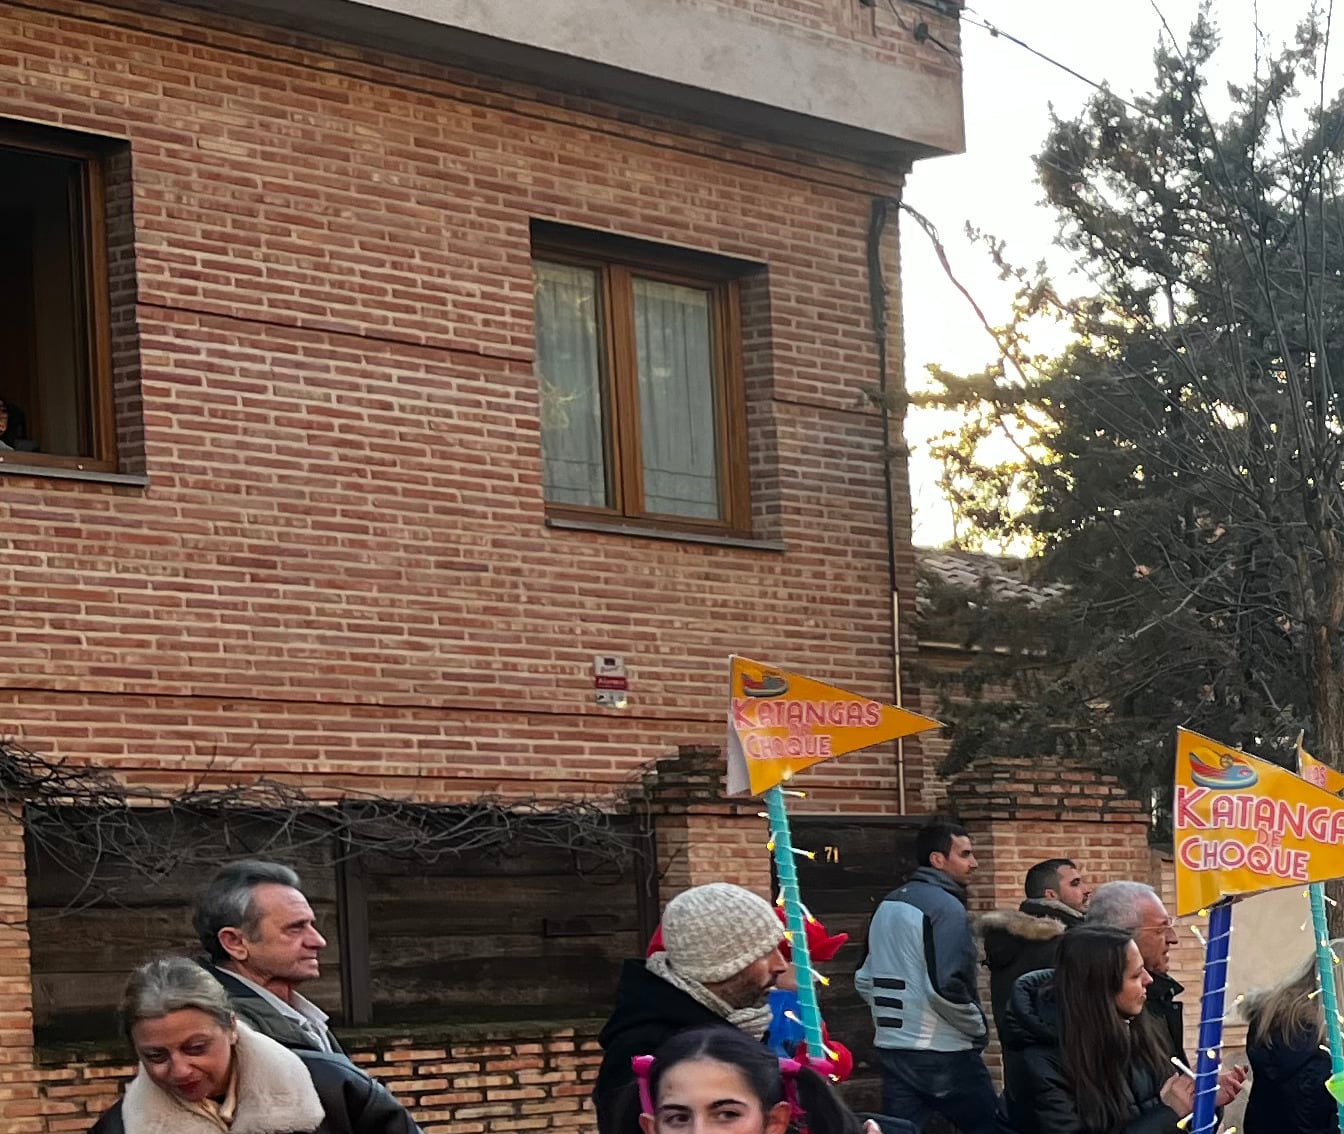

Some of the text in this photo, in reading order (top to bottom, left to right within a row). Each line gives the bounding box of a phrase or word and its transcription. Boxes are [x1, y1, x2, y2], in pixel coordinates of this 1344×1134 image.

[733, 697, 882, 728] KATANGAS
[745, 735, 832, 759] CHOQUE
[1257, 829, 1282, 848] DE
[824, 846, 839, 864] 71
[1179, 837, 1310, 880] CHOQUE
